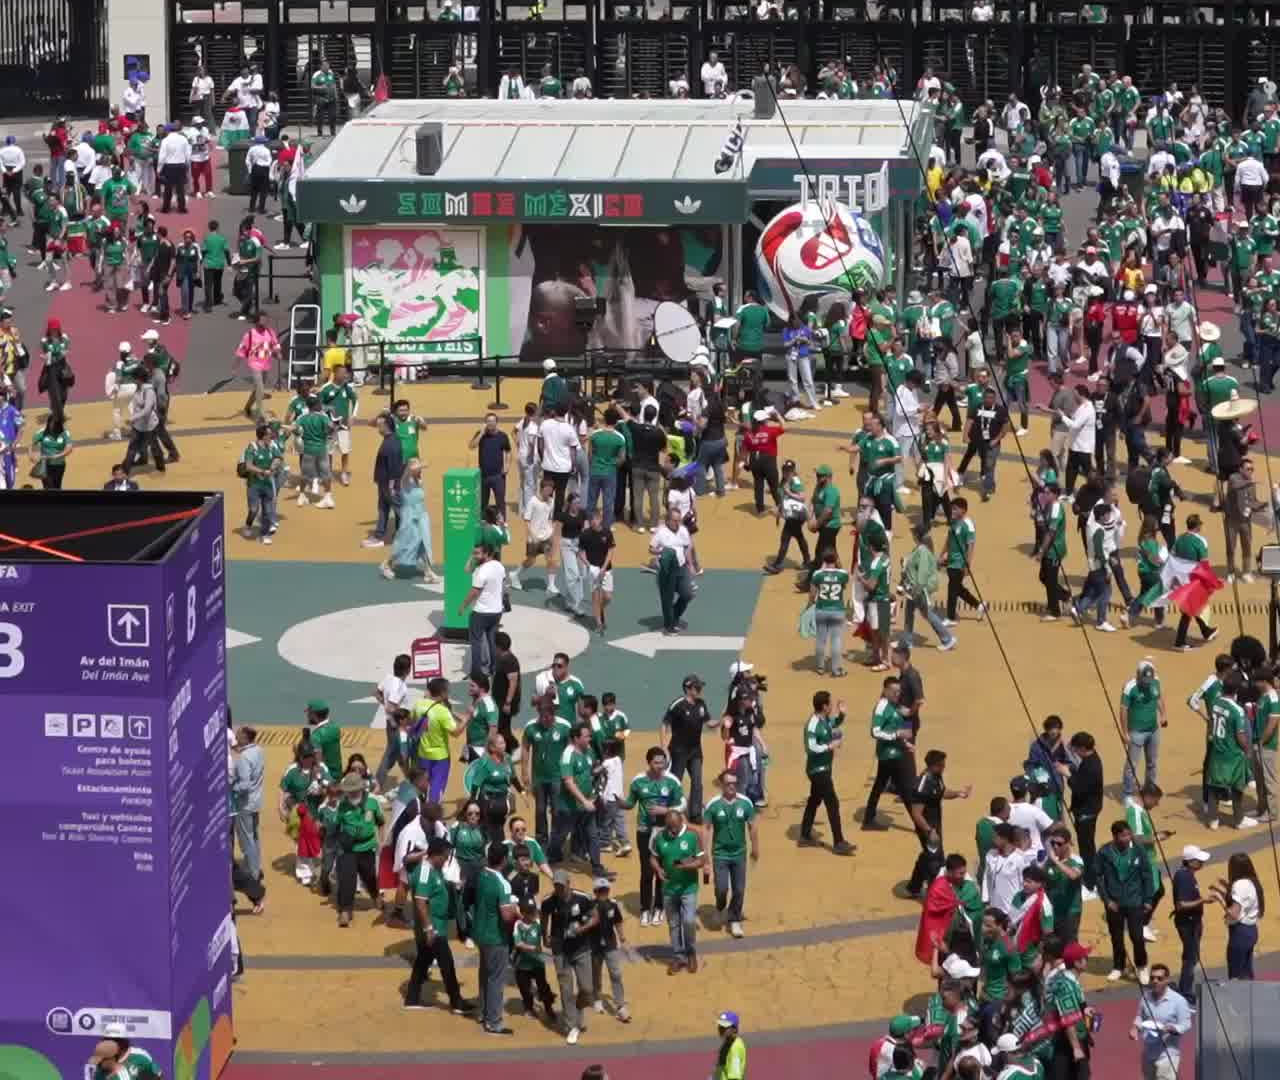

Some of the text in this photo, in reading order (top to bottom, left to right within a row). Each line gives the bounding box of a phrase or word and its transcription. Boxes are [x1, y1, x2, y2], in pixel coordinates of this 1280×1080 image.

[398, 187, 643, 218] SOMOS MÉXICO
[819, 584, 841, 601] 22
[12, 602, 35, 613] EXIT
[80, 656, 150, 668] Av del Imán
[81, 670, 100, 681] Del
[101, 670, 130, 682] Imán
[78, 719, 93, 733] P
[77, 784, 152, 794] Estacionamiento
